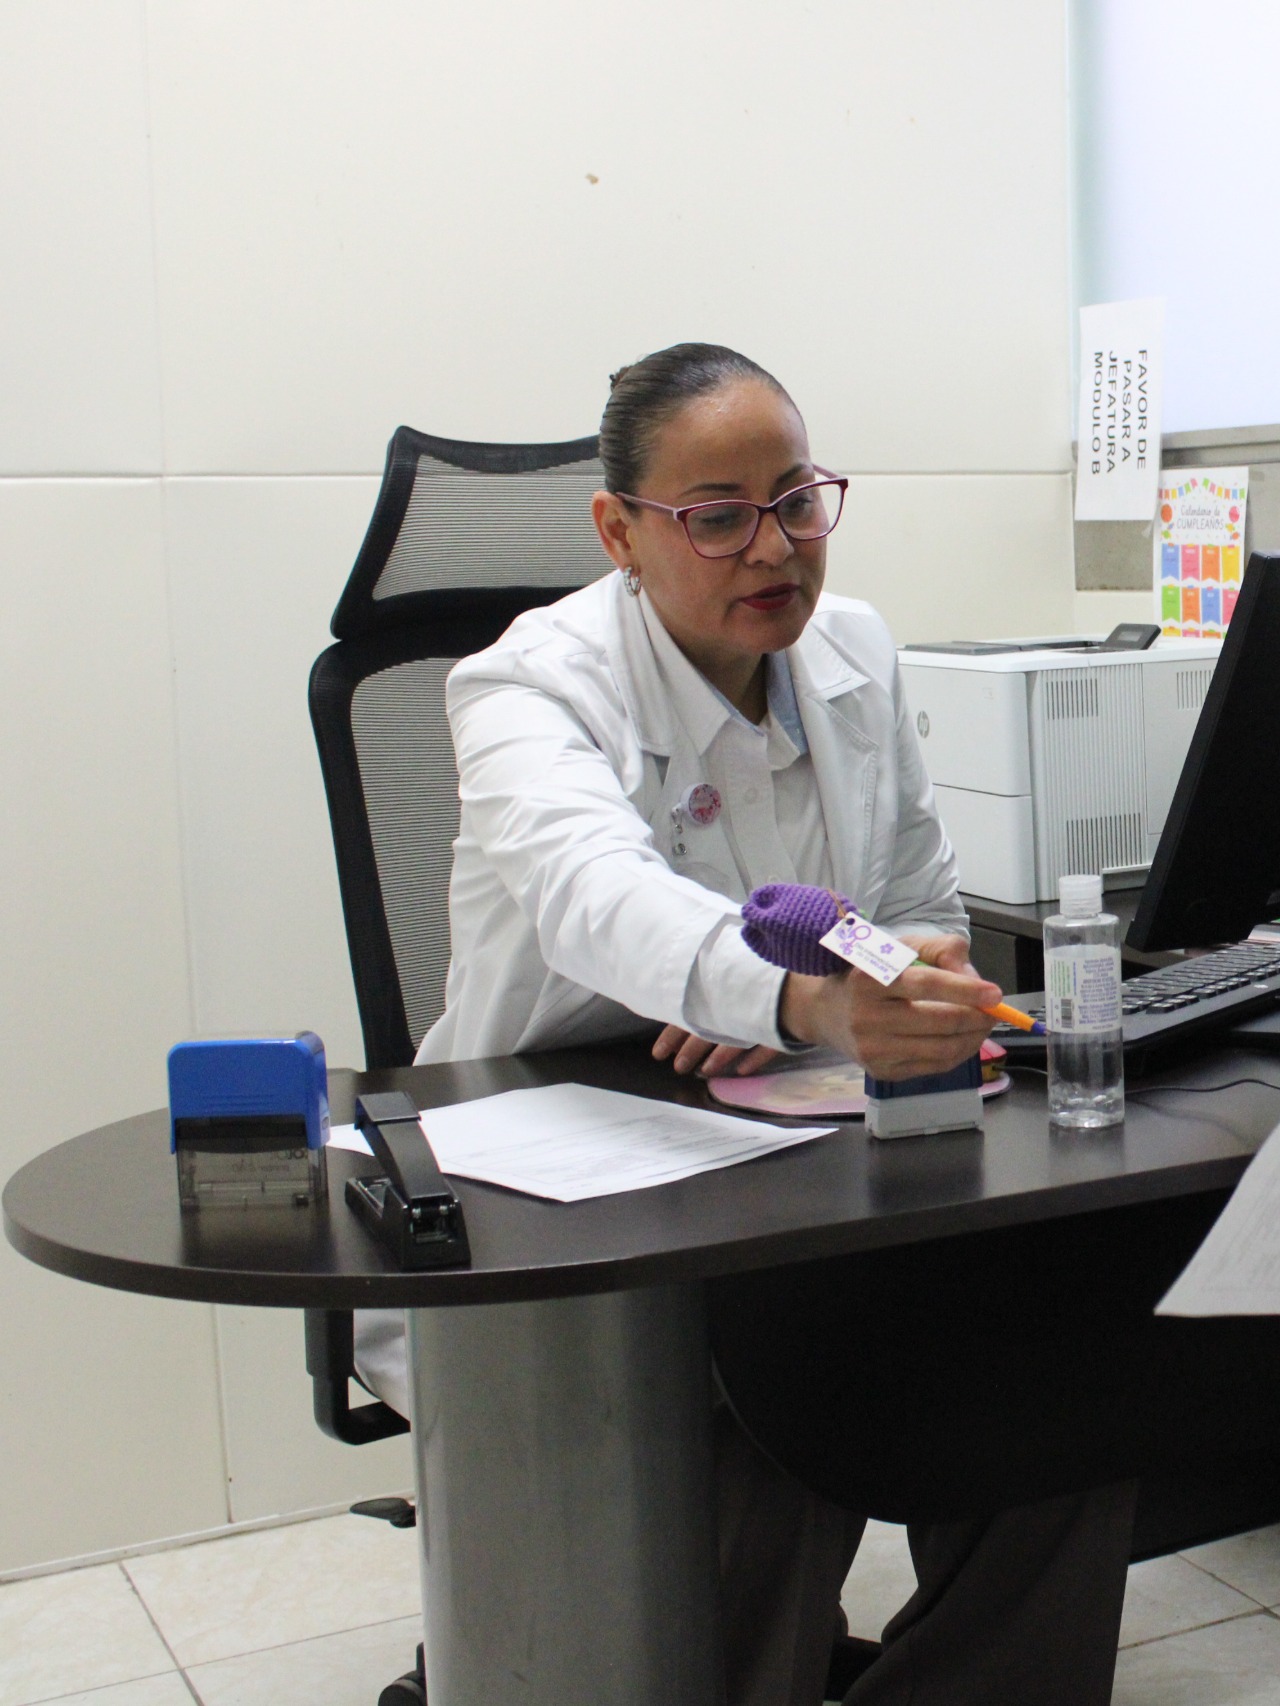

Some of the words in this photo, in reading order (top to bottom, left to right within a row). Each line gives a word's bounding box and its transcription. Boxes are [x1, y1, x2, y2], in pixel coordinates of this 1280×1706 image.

[1092, 351, 1104, 453] MODULO
[1122, 359, 1132, 439] PASAR
[1138, 349, 1148, 431] FAVOR
[1107, 350, 1118, 473] JEFATURA
[1091, 460, 1101, 475] B
[1121, 446, 1131, 462] A
[1137, 438, 1147, 470] DE
[1176, 516, 1225, 531] CUMPLEAÑOS
[1180, 504, 1212, 517] Calendario
